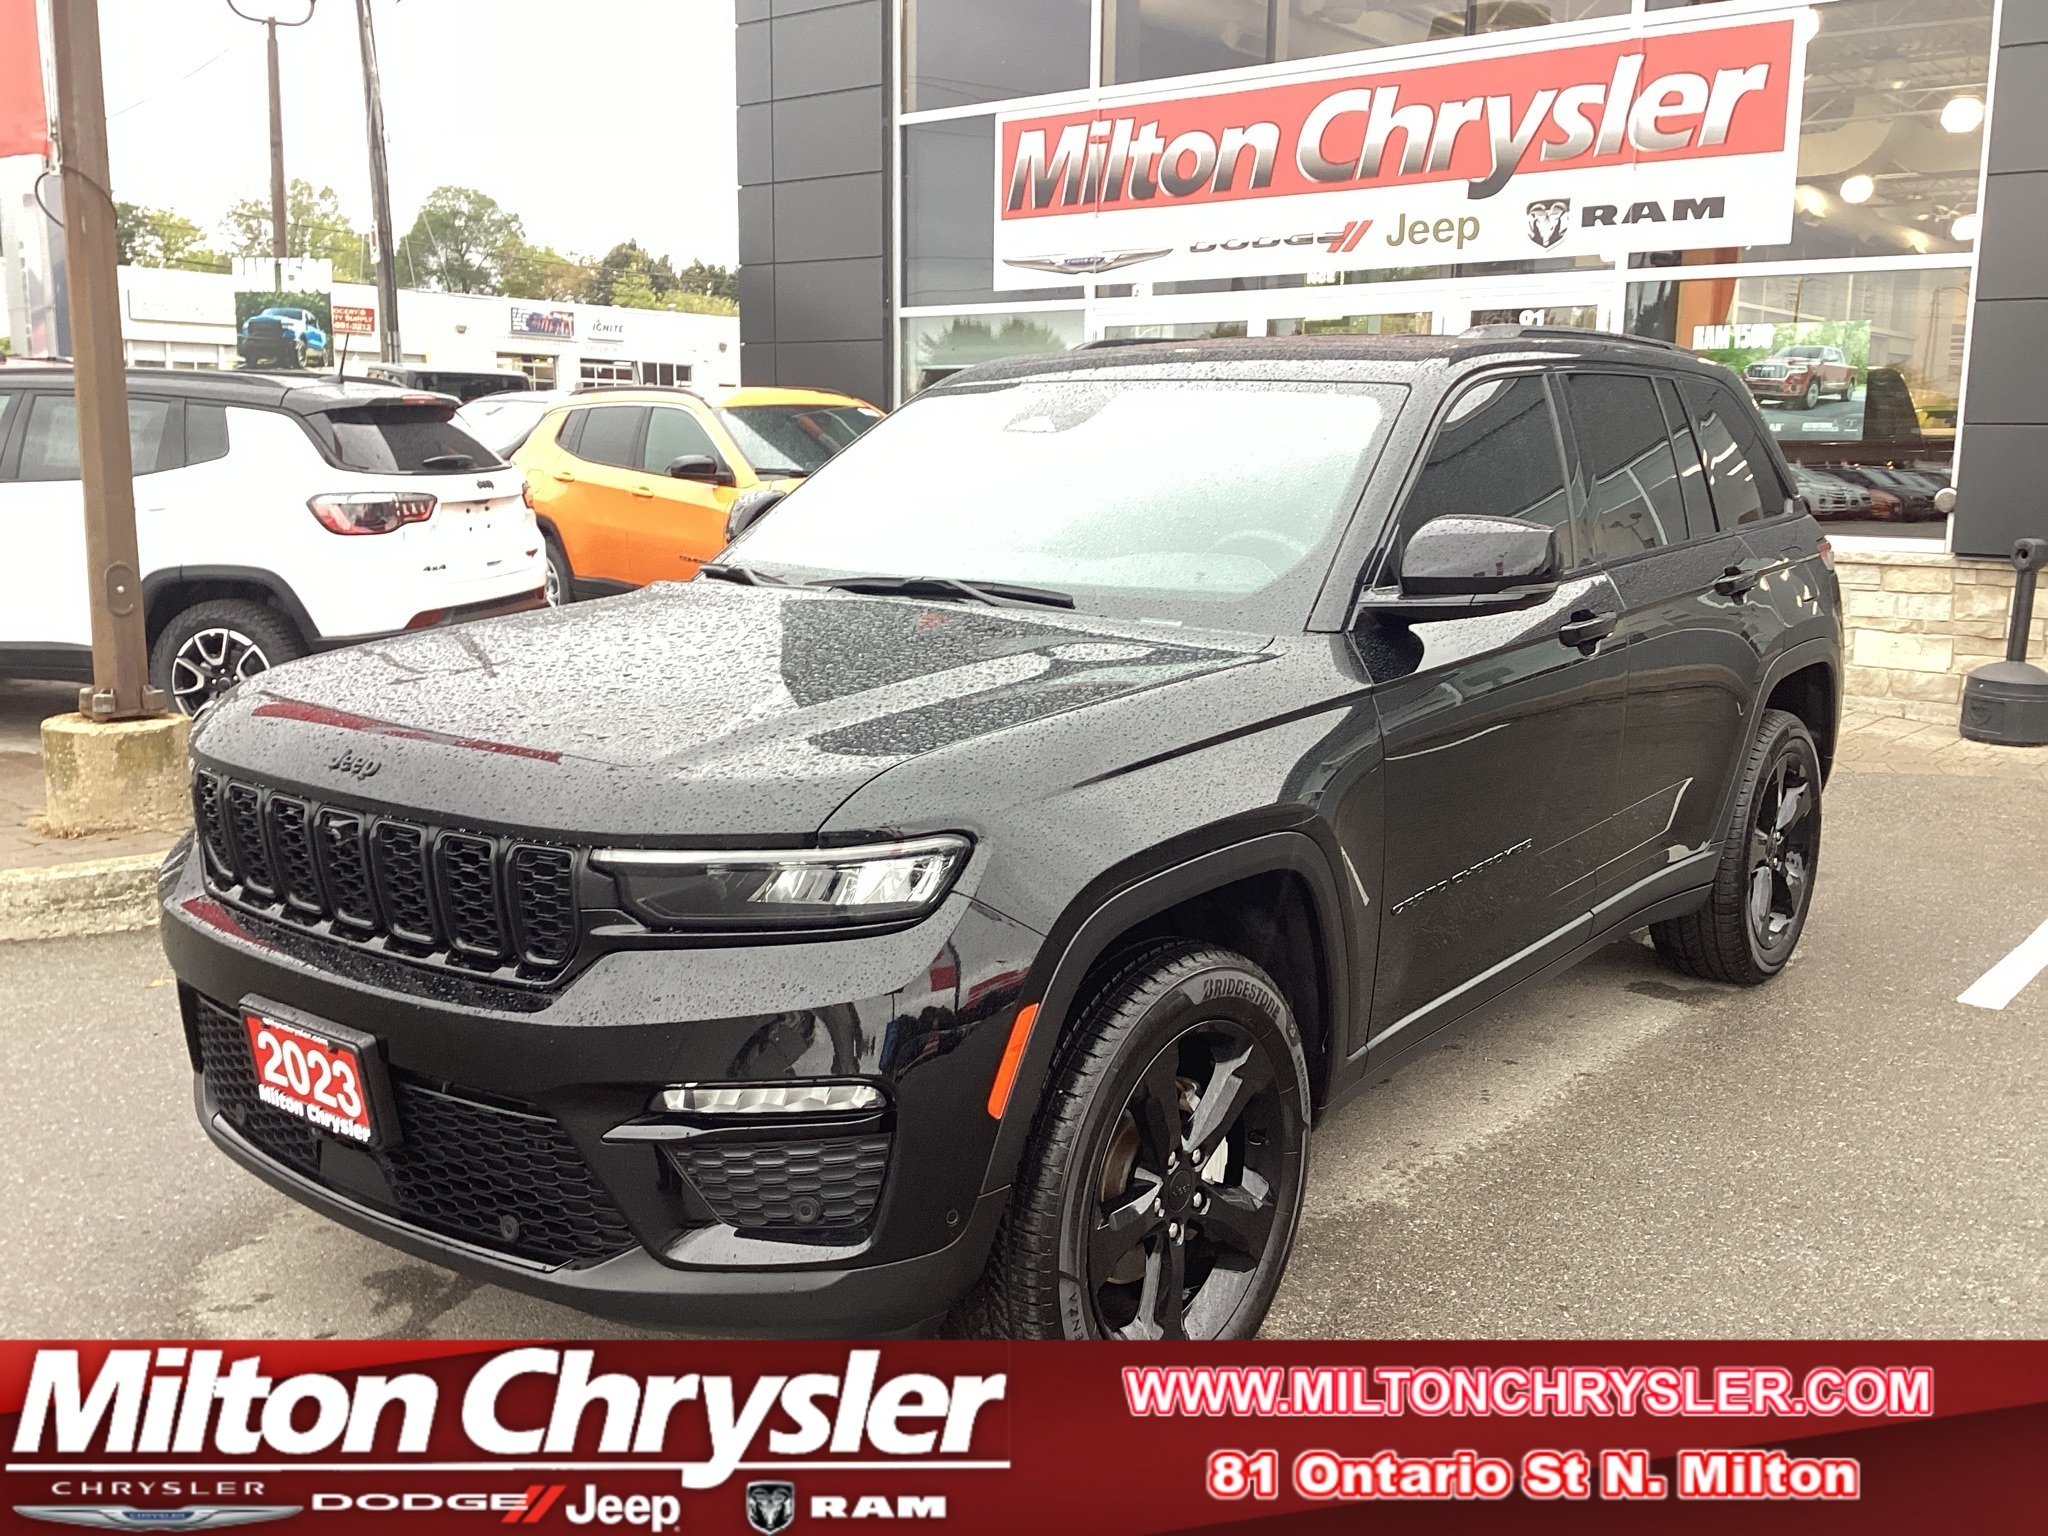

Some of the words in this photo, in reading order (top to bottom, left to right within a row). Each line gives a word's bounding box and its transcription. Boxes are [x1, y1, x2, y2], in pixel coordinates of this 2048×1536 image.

[1007, 117, 1281, 213] Milton
[1295, 54, 1770, 200] Chrysler
[1386, 212, 1481, 250] Jeep
[1582, 196, 1726, 228] RAM
[328, 748, 382, 782] Jeep
[1202, 977, 1282, 1021] BRIDGESTONE
[257, 1030, 362, 1118] 2023
[258, 1083, 304, 1118] Milton
[306, 1103, 371, 1143] Chrysler
